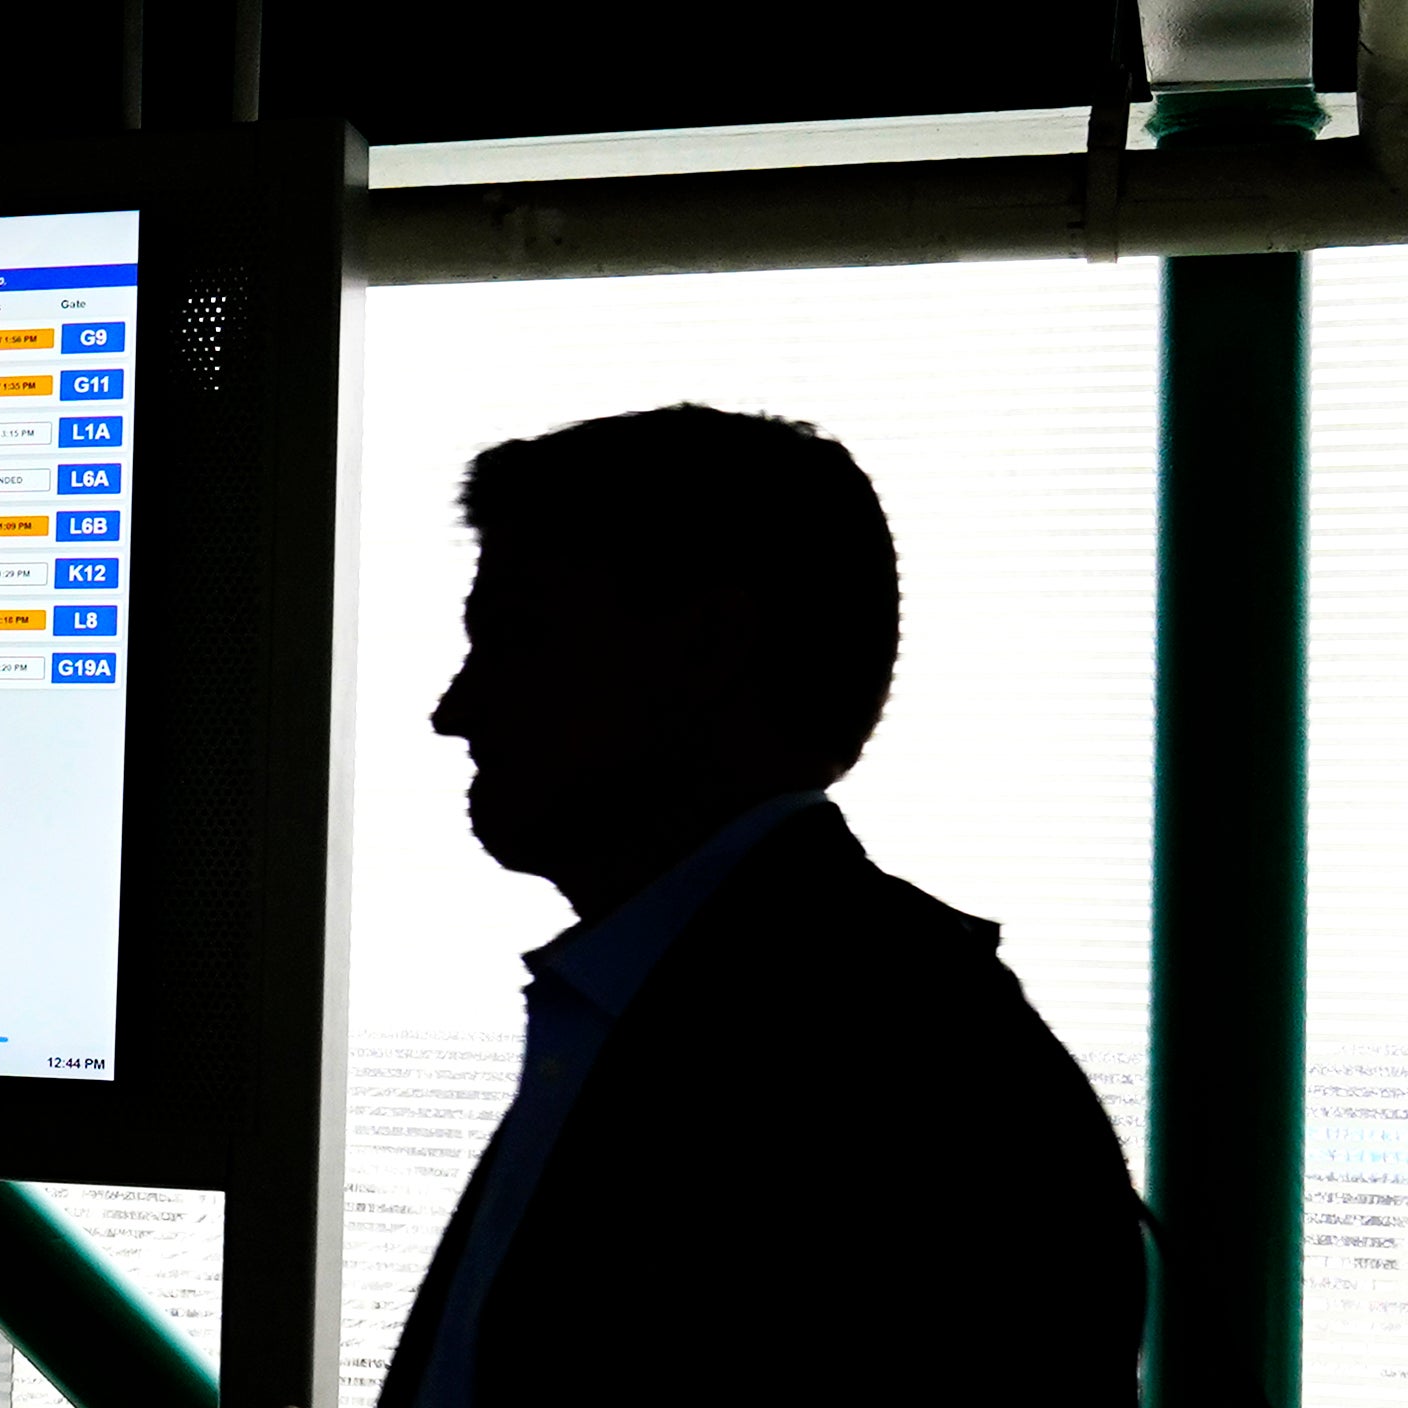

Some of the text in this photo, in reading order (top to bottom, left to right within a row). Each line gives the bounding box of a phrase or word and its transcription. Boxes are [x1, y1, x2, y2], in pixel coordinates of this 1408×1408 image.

[61, 300, 86, 309] Gate
[80, 329, 107, 346] G9
[74, 376, 109, 393] G11
[73, 423, 110, 440] L1A
[71, 470, 109, 487] L6A
[70, 518, 107, 534] L6B
[69, 565, 106, 581] K12
[74, 612, 97, 629] L8
[58, 660, 111, 676] G19A
[48, 1057, 105, 1070] 12:44 PM
